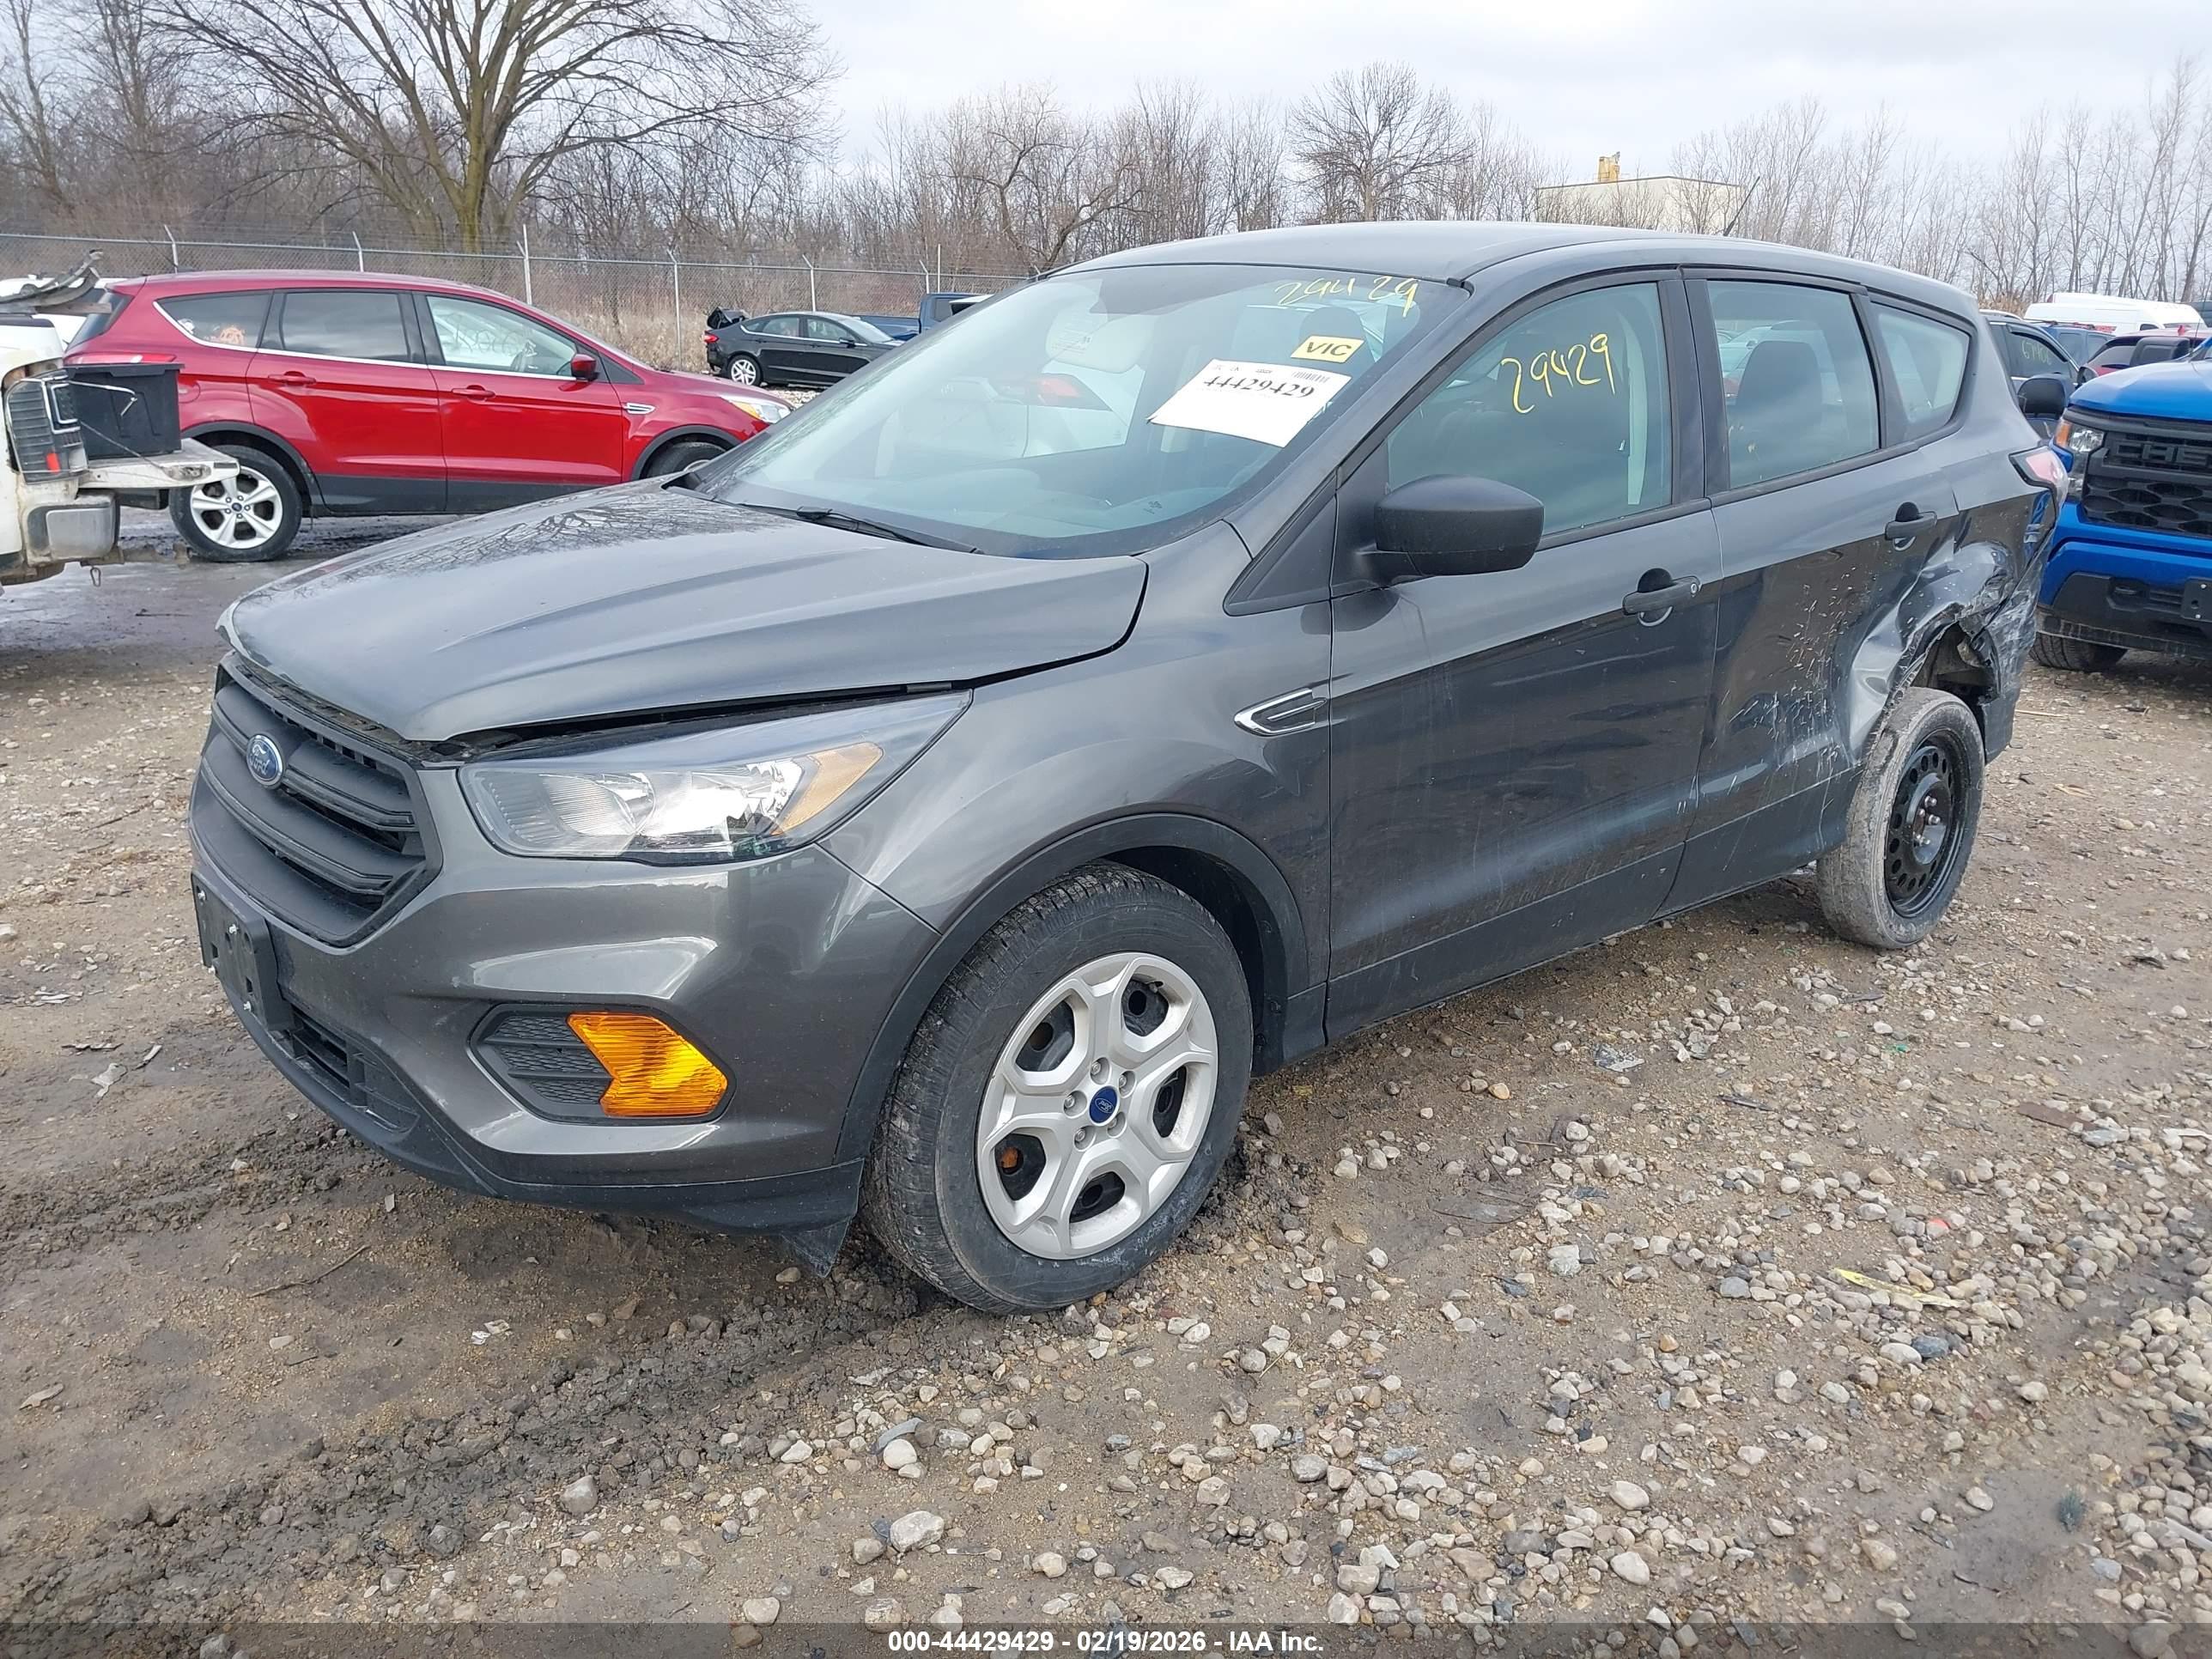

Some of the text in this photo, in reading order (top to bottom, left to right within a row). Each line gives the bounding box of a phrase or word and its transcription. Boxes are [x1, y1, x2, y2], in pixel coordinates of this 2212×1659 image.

[1274, 276, 1419, 318] 29429
[1306, 341, 1352, 356] VIC
[1204, 375, 1315, 398] 44429429
[1501, 333, 1616, 414] 29429
[250, 744, 270, 775] Ford
